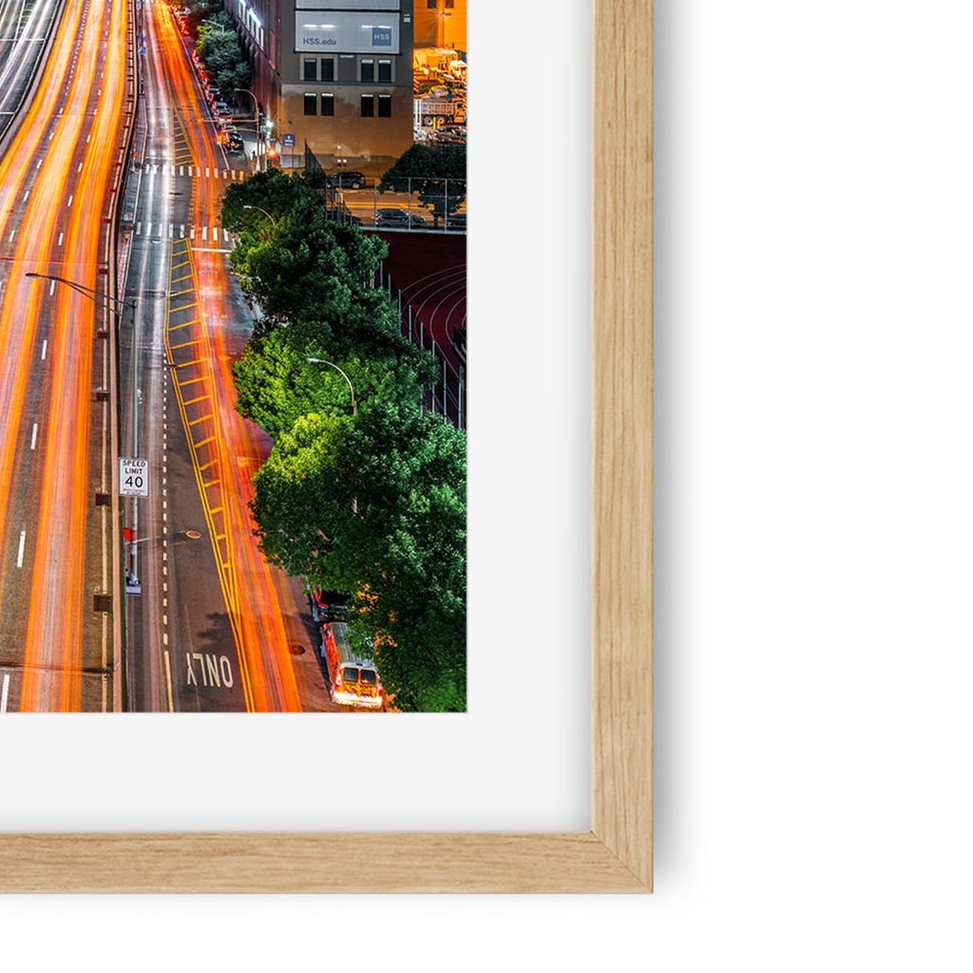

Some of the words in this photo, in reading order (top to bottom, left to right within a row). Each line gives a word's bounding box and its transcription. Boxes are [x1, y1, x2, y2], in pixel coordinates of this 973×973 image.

[302, 37, 337, 45] HSS.edu
[374, 33, 390, 41] HSS
[123, 459, 146, 467] SPEED
[125, 476, 143, 488] 40
[186, 652, 234, 688] ONLY
